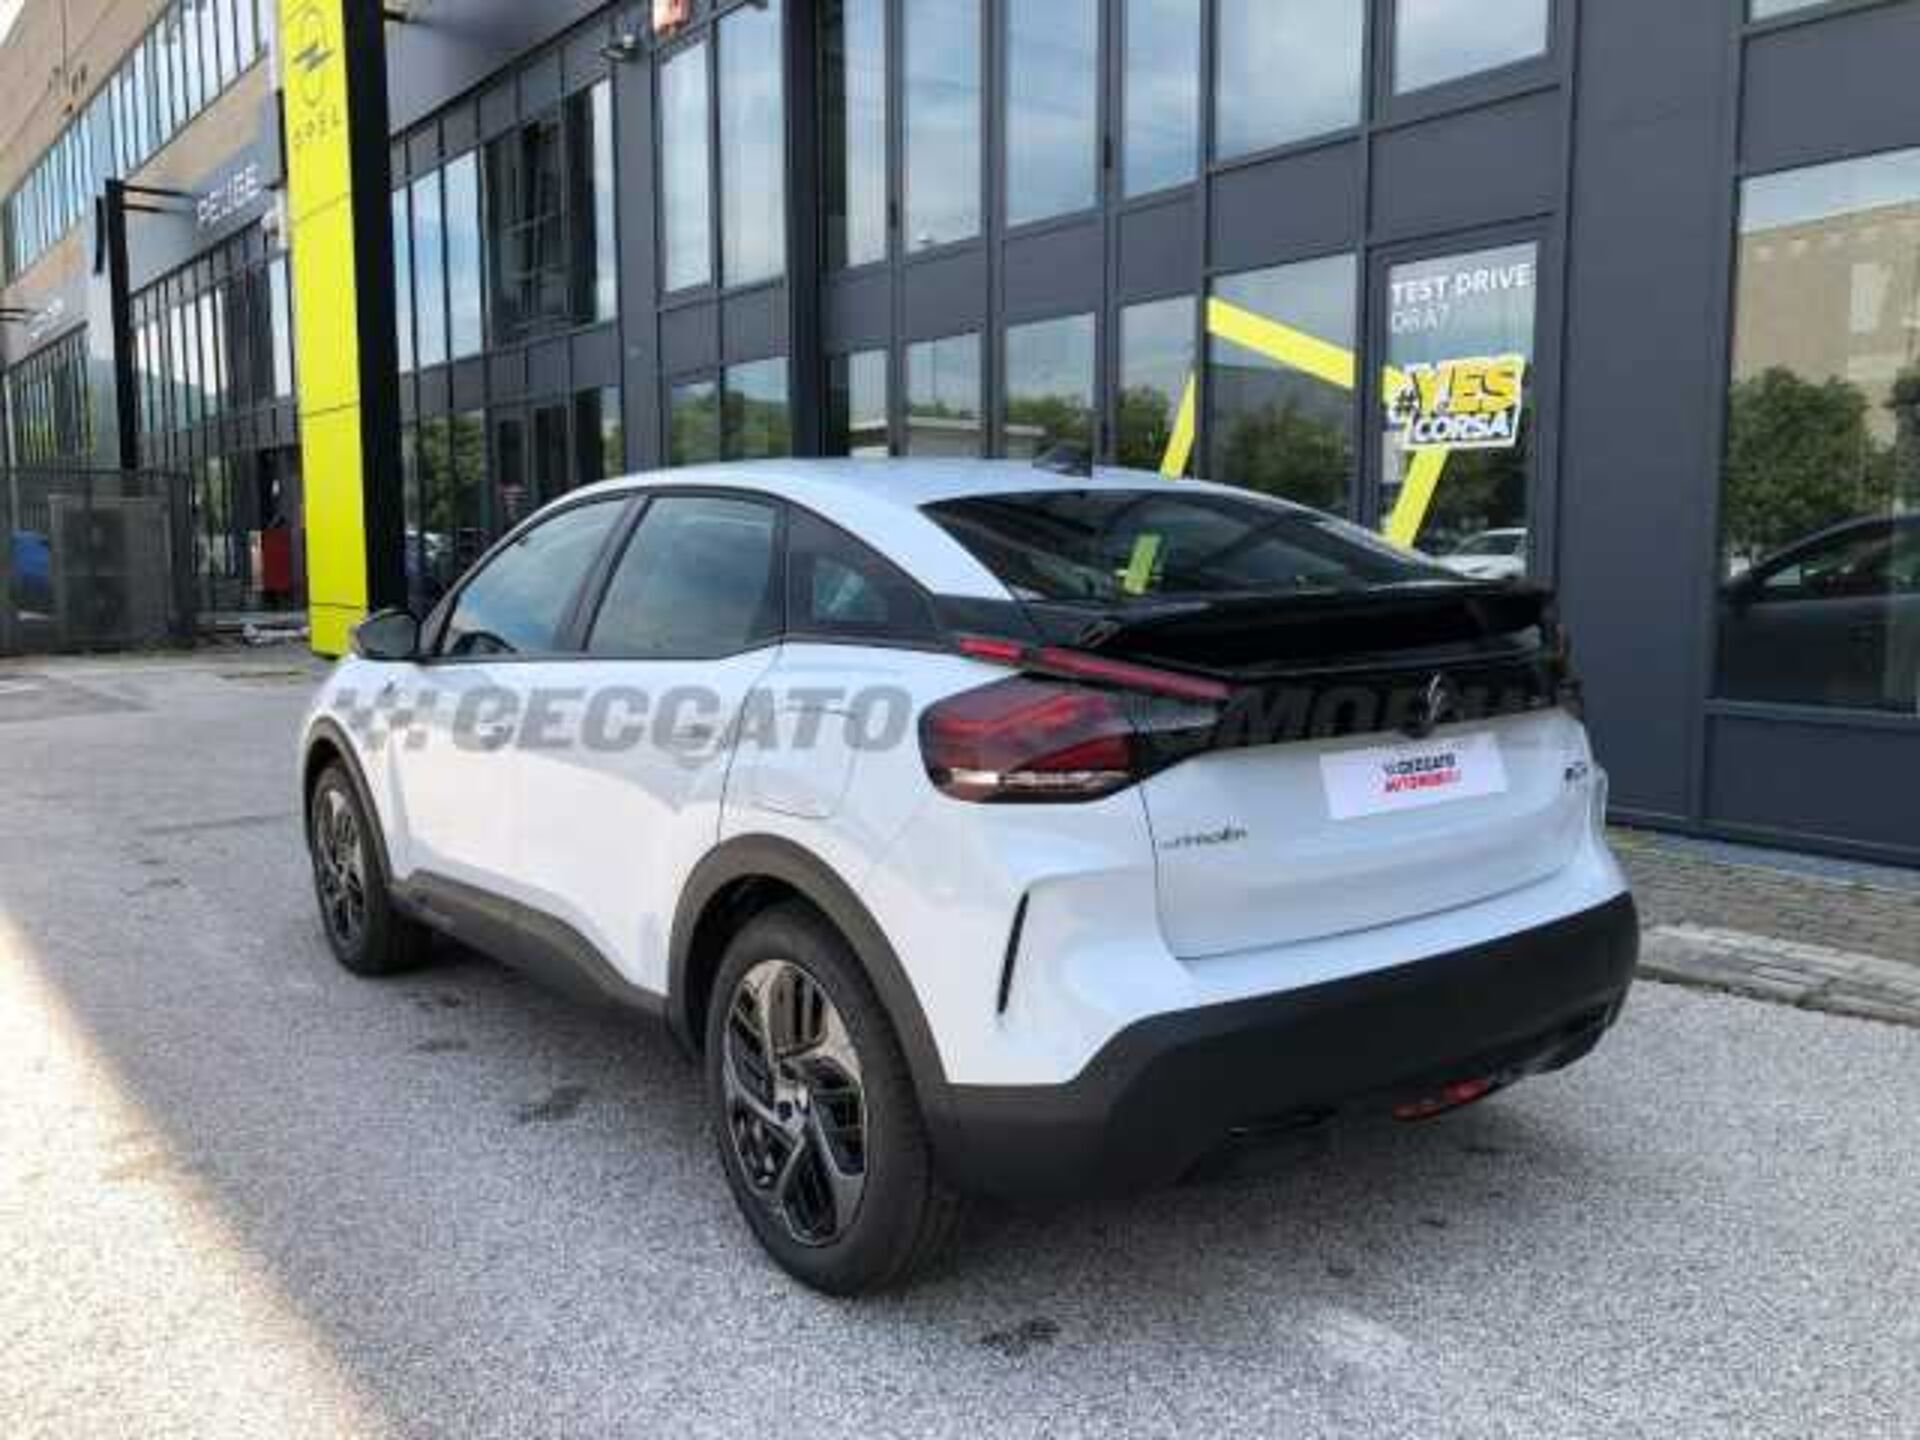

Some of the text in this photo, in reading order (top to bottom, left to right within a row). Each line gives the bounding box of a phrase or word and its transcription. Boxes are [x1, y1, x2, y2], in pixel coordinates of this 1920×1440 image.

[1391, 263, 1531, 305] TEST DRIVE
[1414, 411, 1511, 441] CORSA
